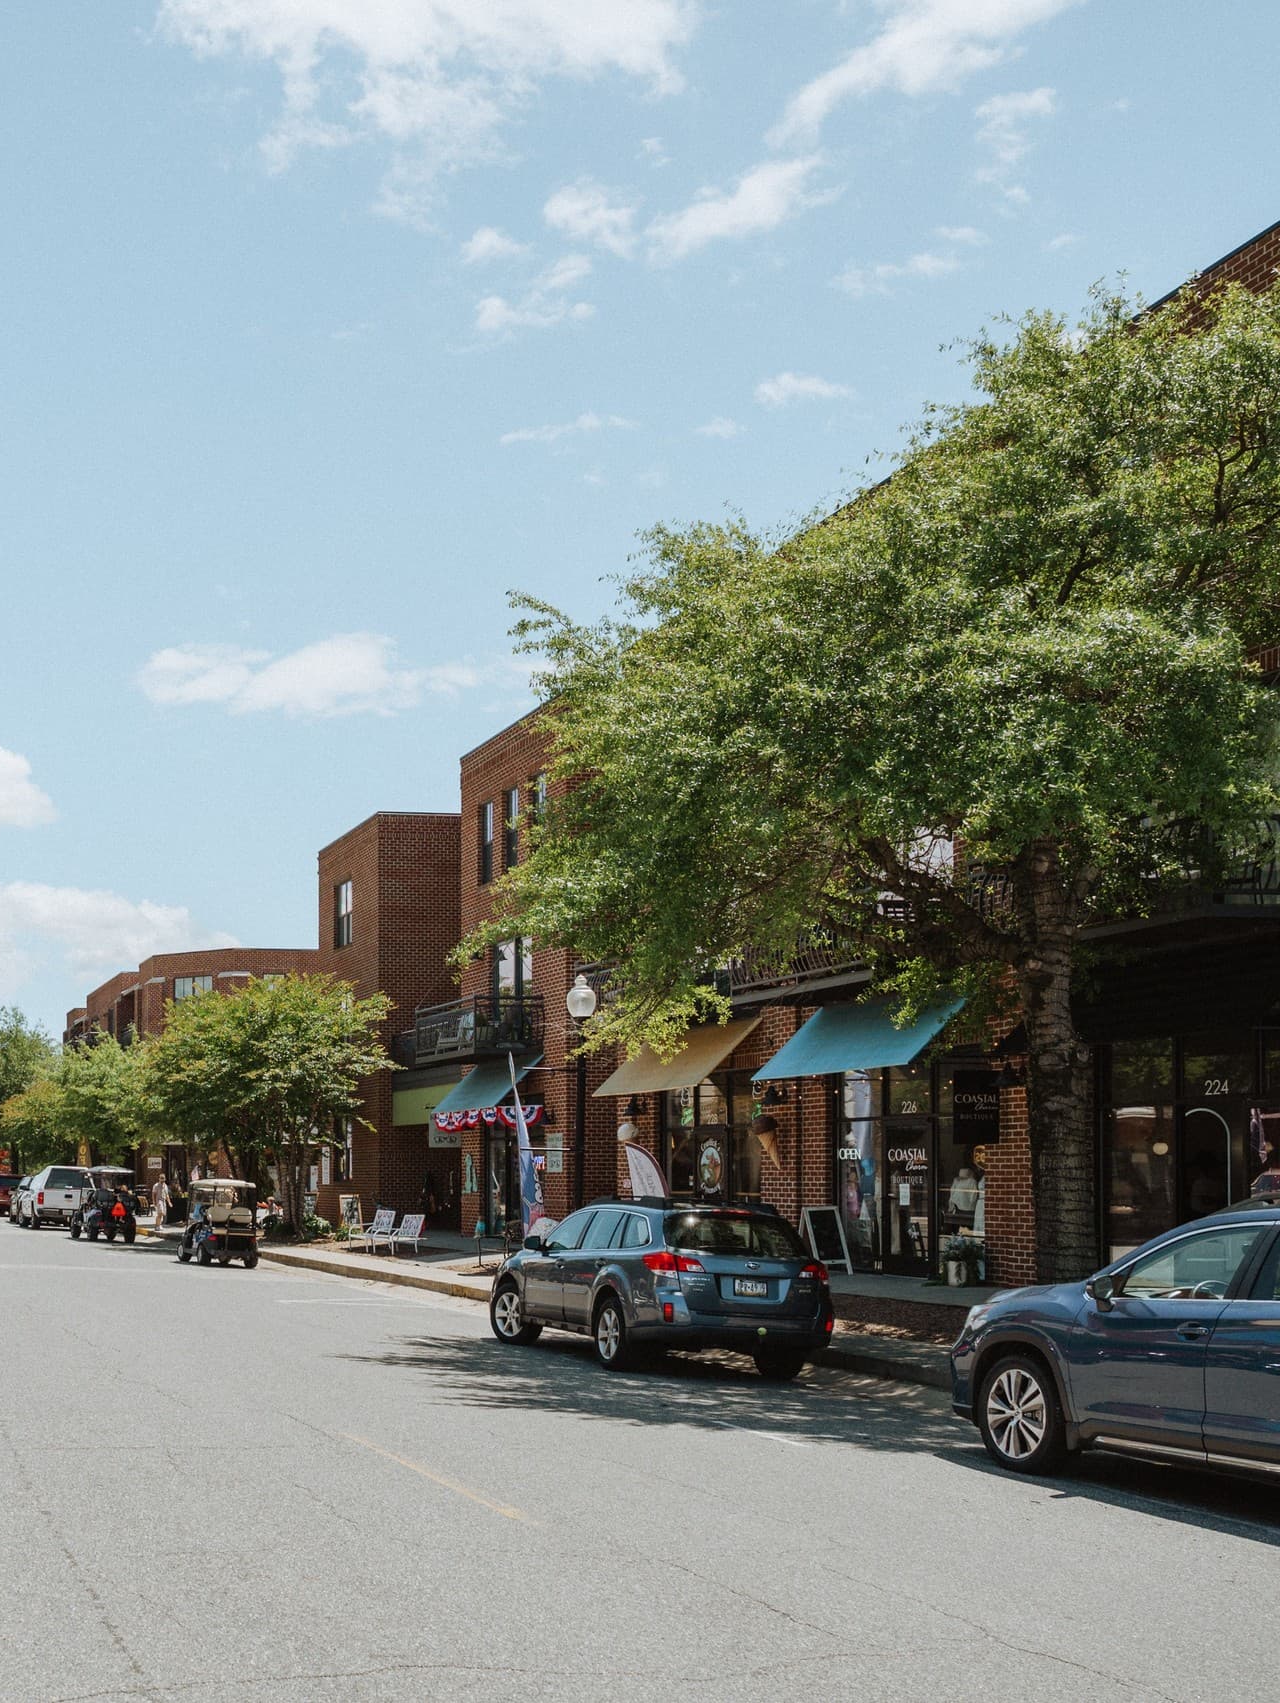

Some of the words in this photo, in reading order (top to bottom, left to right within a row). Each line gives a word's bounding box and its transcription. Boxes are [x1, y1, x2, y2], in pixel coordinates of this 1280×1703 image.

[1205, 1080, 1229, 1095] 224
[955, 1093, 998, 1104] COASTAL
[902, 1101, 918, 1113] 226
[839, 1148, 861, 1160] OPEN
[888, 1149, 928, 1161] COASTAL
[905, 1160, 928, 1172] Charm
[892, 1175, 924, 1185] BOUTIQUE
